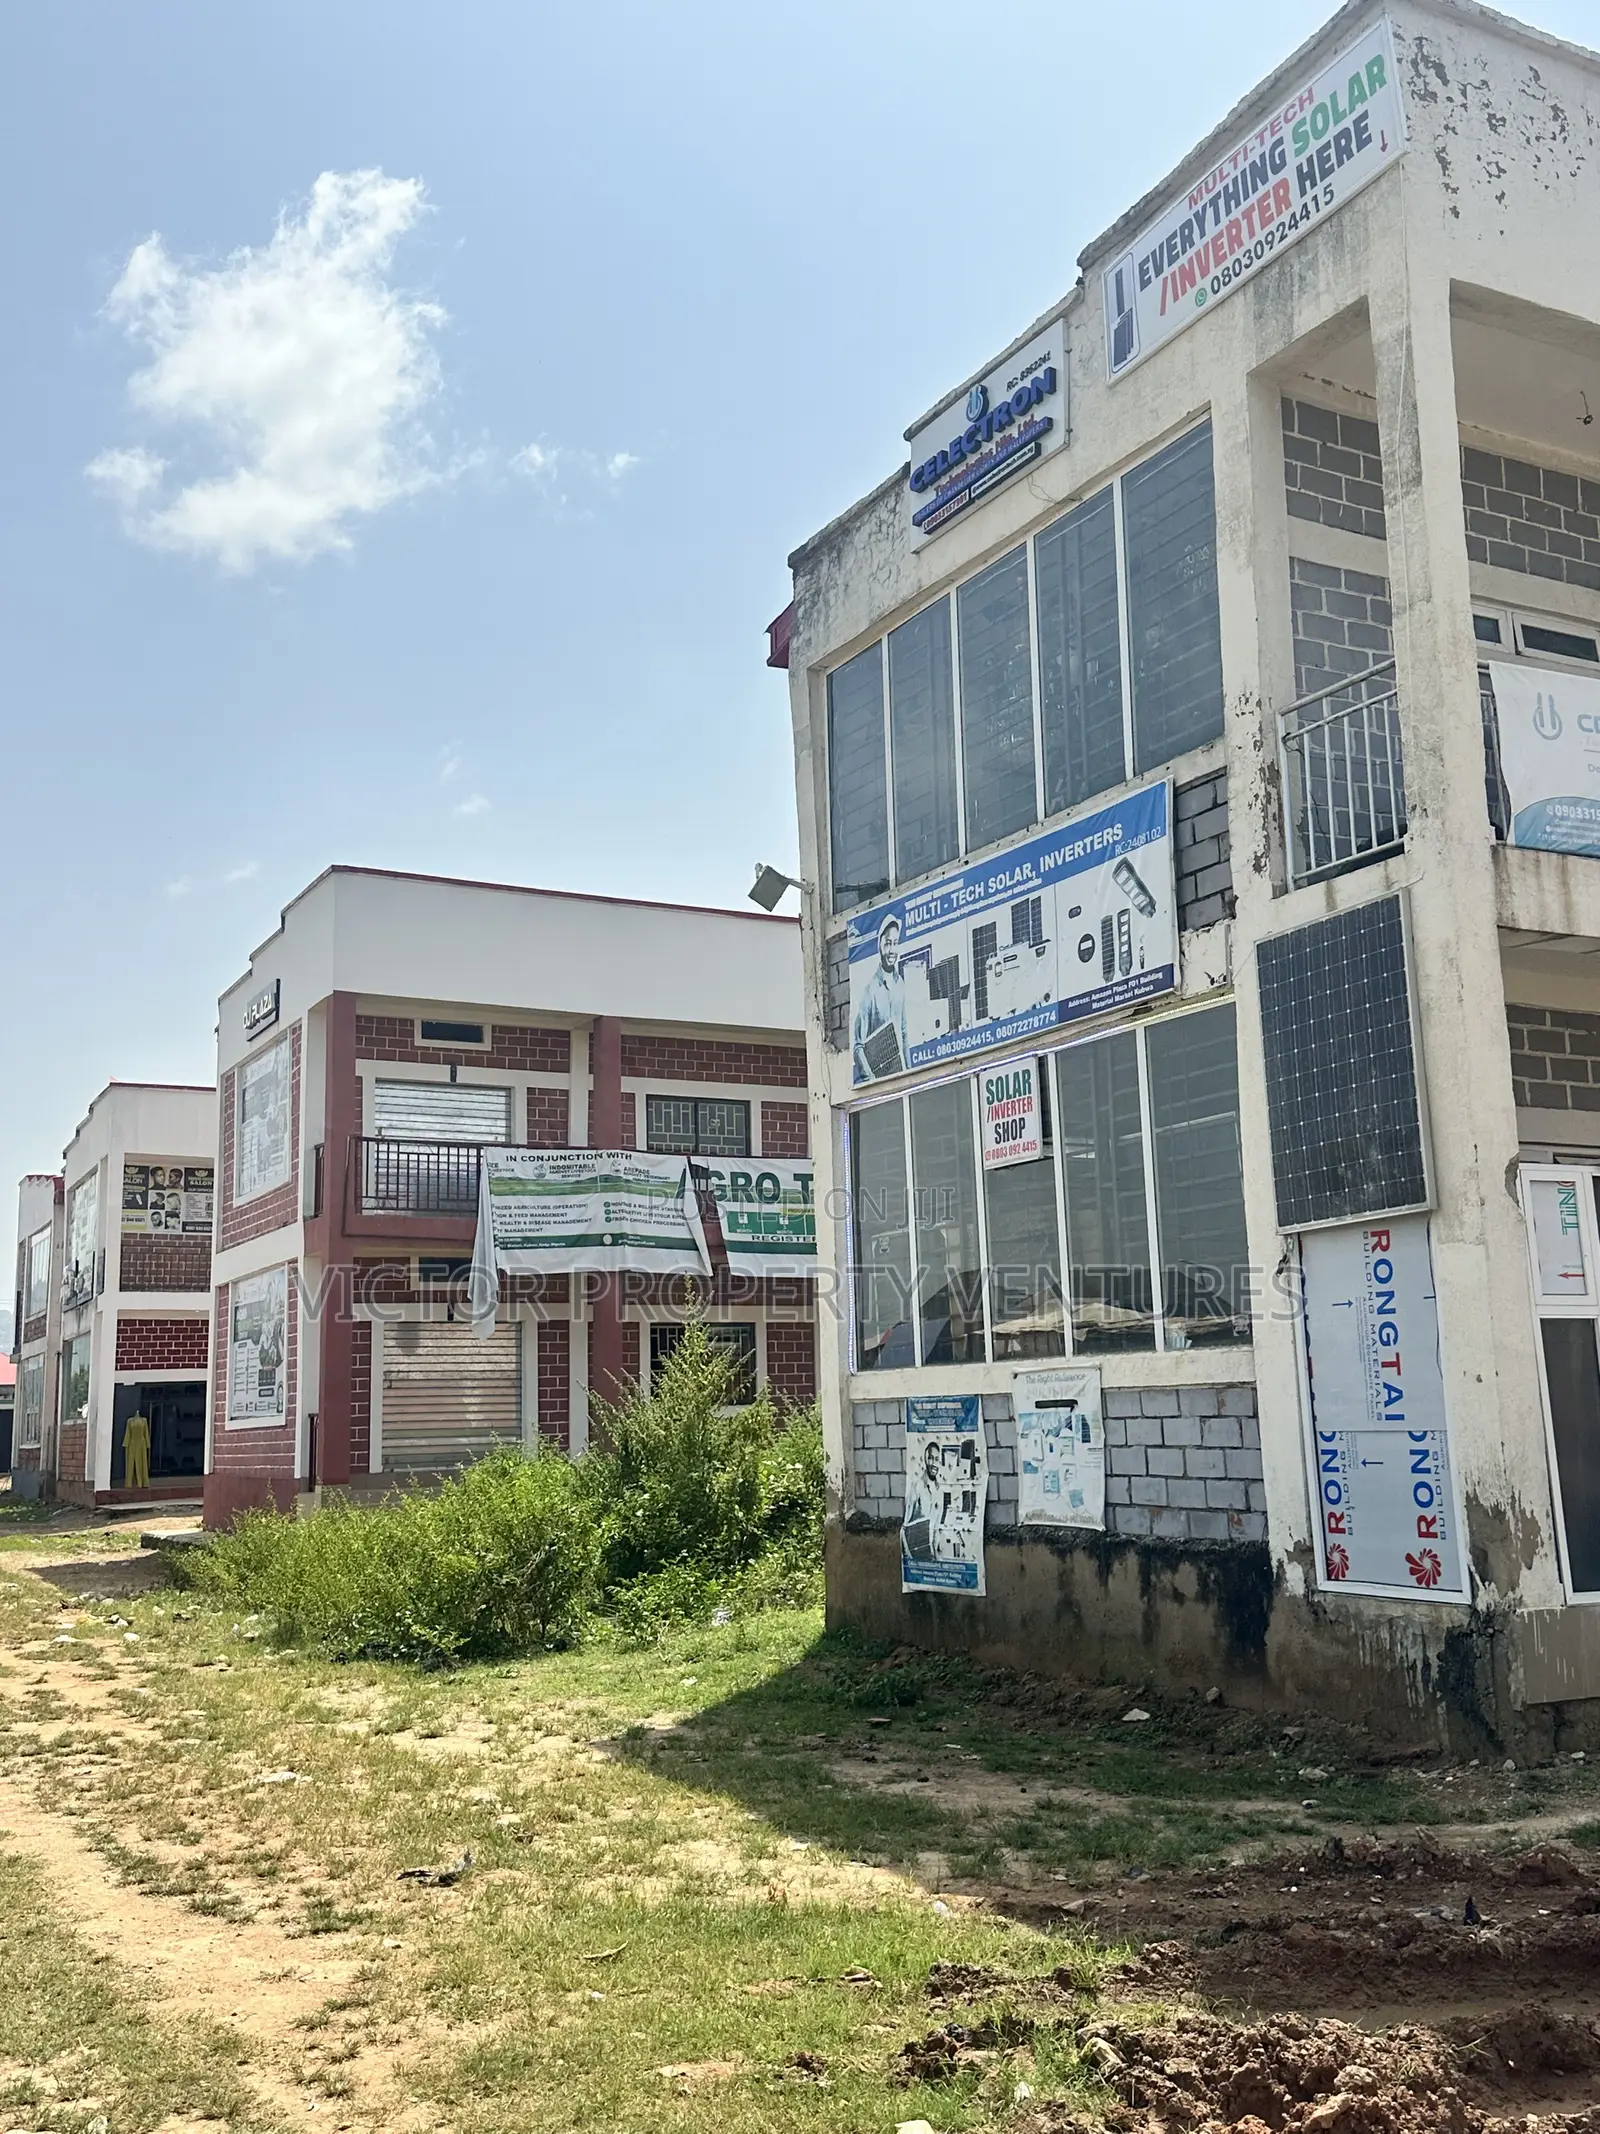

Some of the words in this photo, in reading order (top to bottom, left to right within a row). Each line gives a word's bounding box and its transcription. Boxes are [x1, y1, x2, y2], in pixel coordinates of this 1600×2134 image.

[1139, 136, 1287, 292] EVERYTHING
[1292, 54, 1387, 157] SOLAR
[1188, 86, 1315, 210] MULTI-TECH
[1160, 177, 1292, 316] /INVERTER
[1295, 109, 1373, 198] HERE
[1210, 183, 1335, 295] 08030924415
[909, 366, 1057, 493] CELECTRON
[905, 900, 941, 927] MULTI
[951, 882, 984, 908] TECH
[988, 862, 1036, 894] SOLAR,
[1040, 823, 1123, 873] INVERTERS
[912, 1050, 935, 1063] CALL:
[996, 1011, 1056, 1039] 08072278774
[986, 1069, 1032, 1105] SOLAR
[987, 1096, 1033, 1123] /INVERTER
[994, 1117, 1026, 1144] SHOP
[520, 1152, 603, 1163] CONJUNCTION
[605, 1152, 632, 1161] WITH
[1021, 1140, 1037, 1153] 4415
[1362, 1231, 1376, 1314] BUILDING
[1370, 1323, 1384, 1422] MATERIALS
[1370, 1229, 1405, 1421] RONGTAI
[1339, 1451, 1353, 1536] BUILDING
[1432, 1451, 1446, 1540] BUILDING
